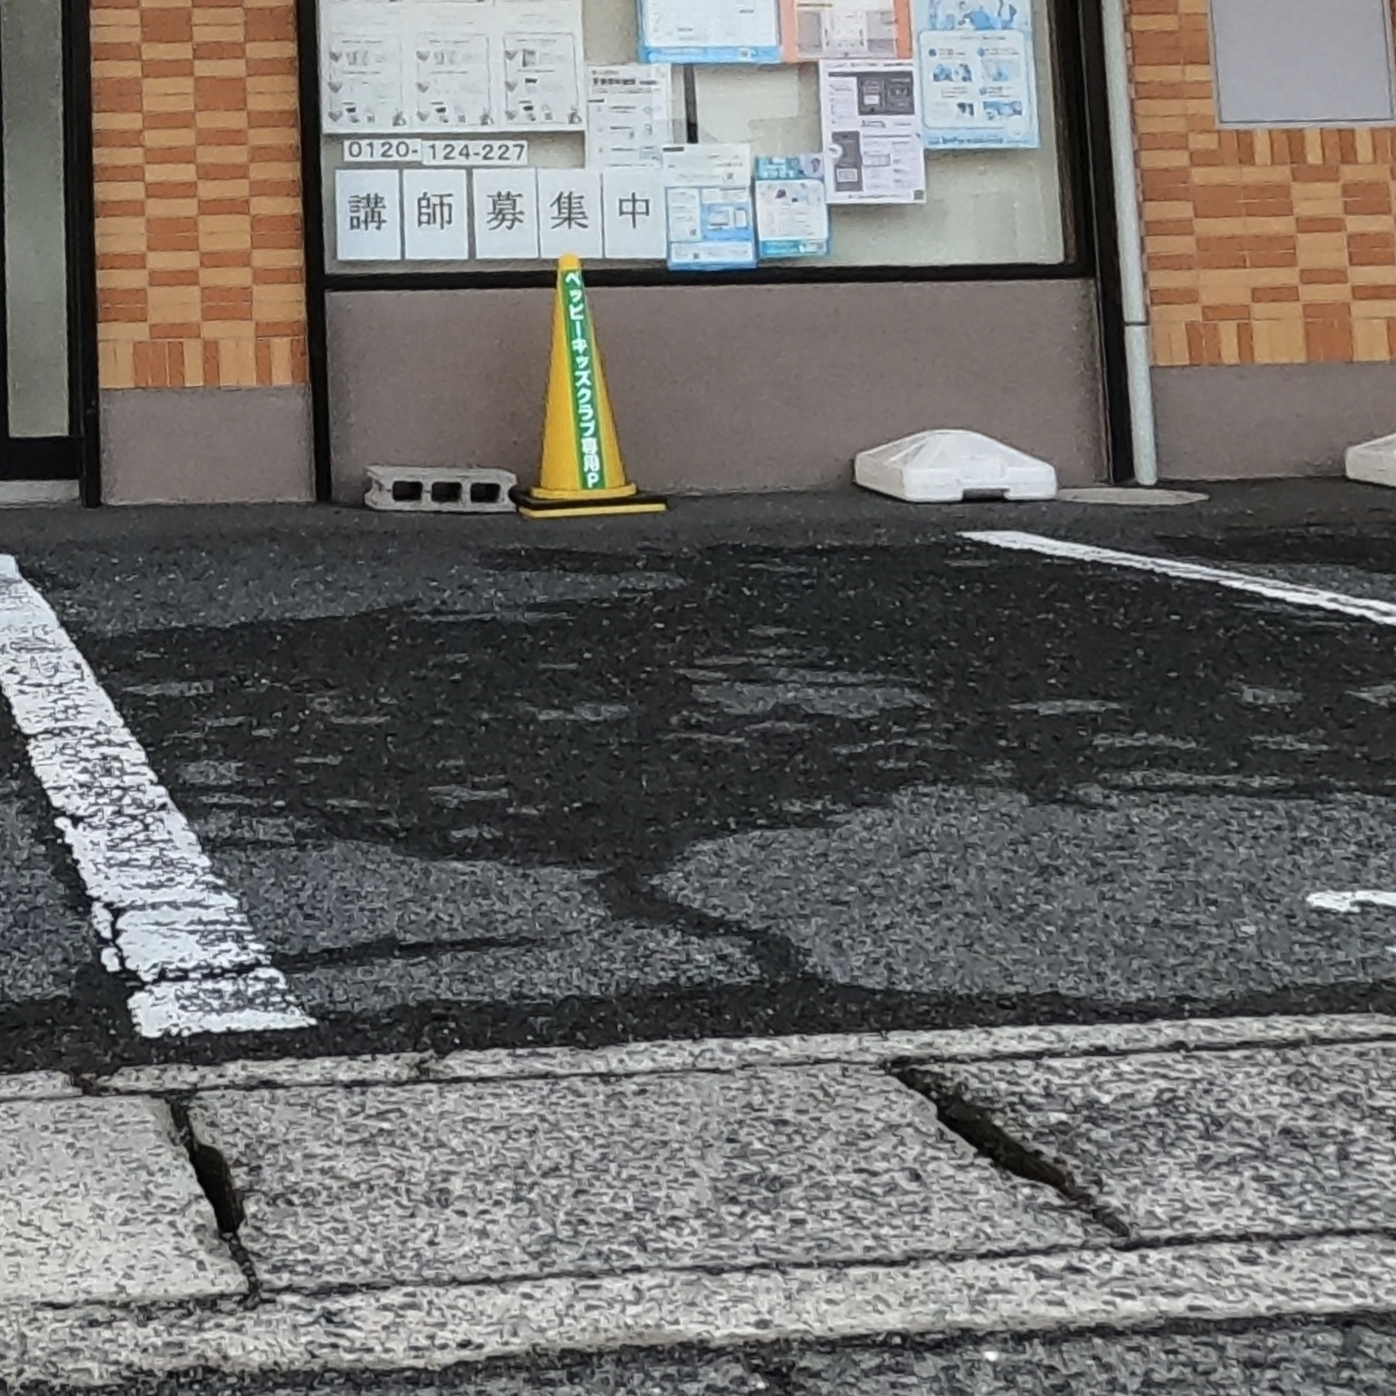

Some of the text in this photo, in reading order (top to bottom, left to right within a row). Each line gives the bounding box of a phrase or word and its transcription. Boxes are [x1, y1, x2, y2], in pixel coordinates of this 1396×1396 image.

[347, 140, 526, 162] 0120-124-227
[347, 190, 651, 231] 講師募集中
